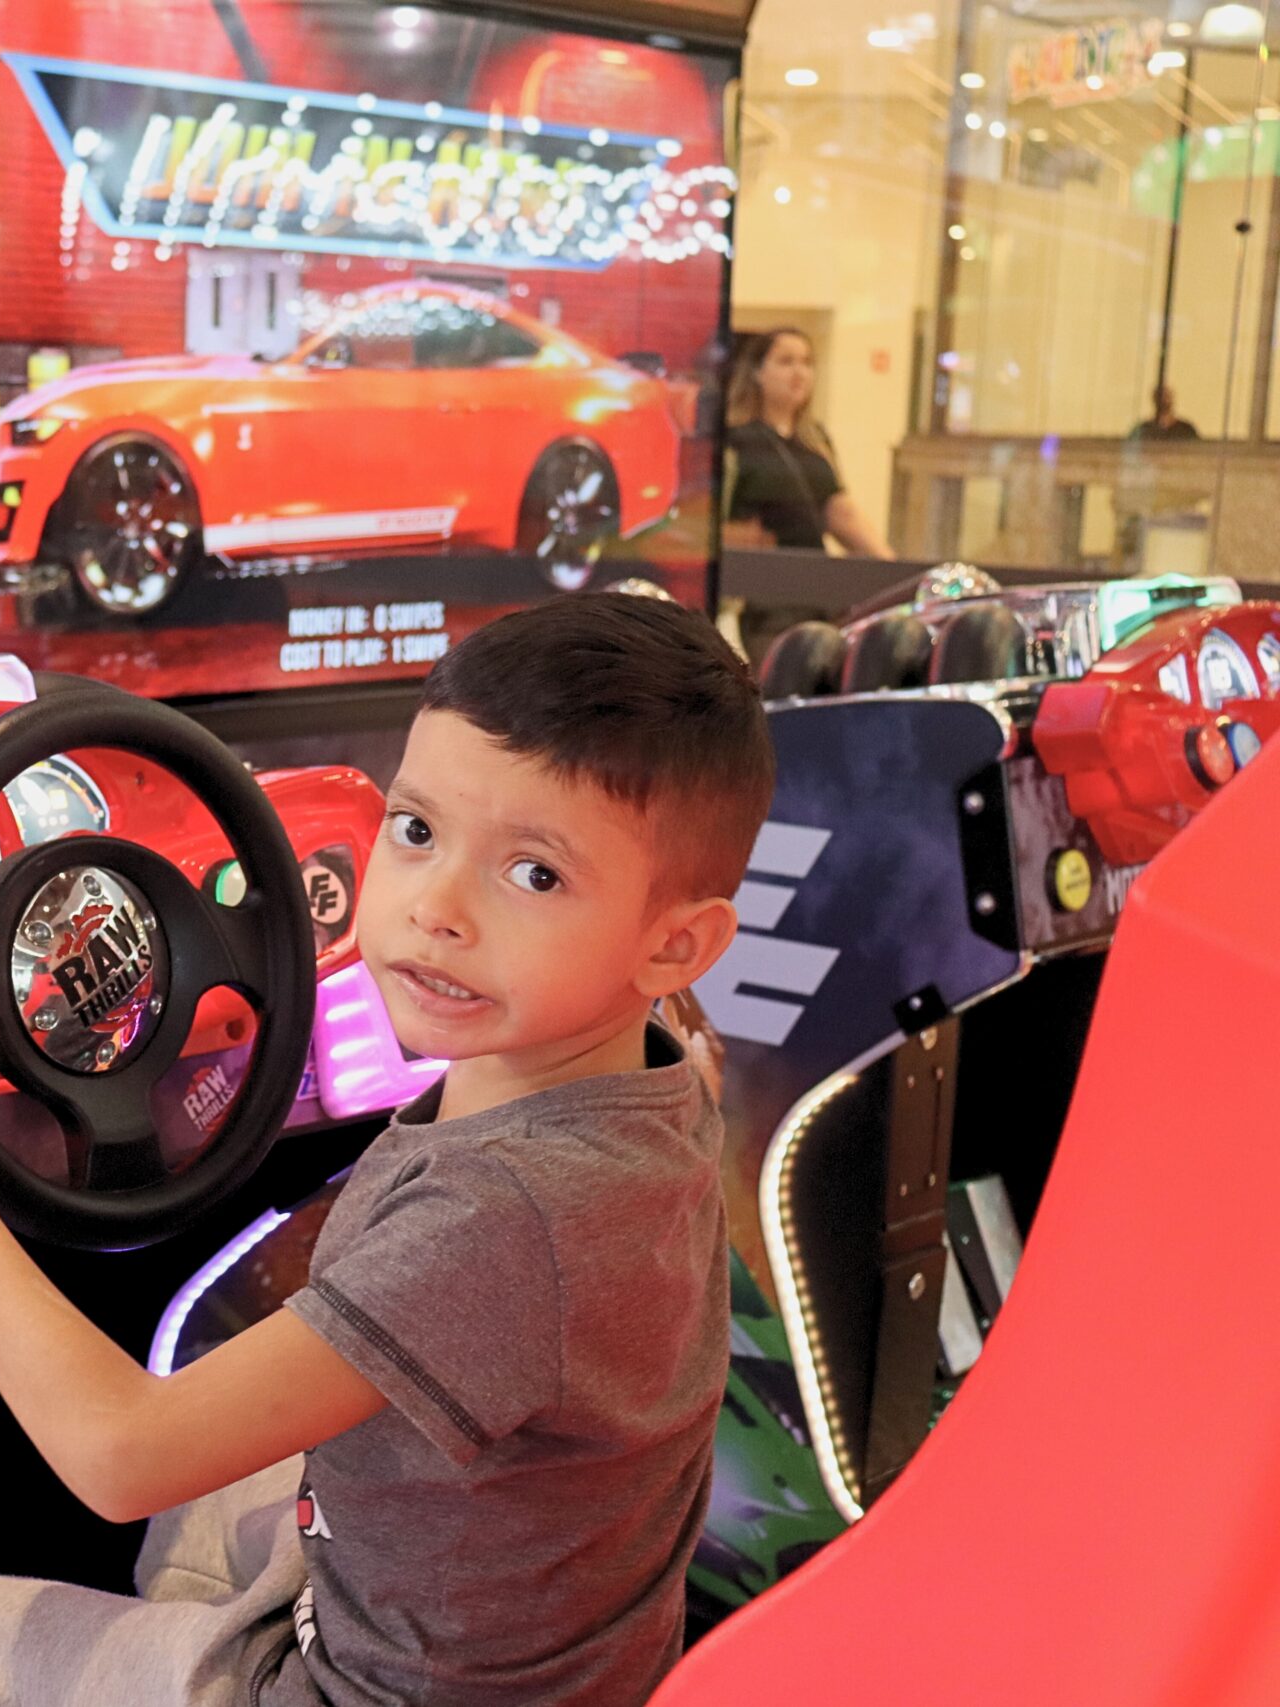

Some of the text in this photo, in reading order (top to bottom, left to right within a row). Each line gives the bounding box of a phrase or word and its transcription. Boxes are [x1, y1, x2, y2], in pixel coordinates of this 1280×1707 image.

[51, 904, 142, 1008] RAW
[72, 944, 154, 1028] THRILLS
[182, 1063, 229, 1121] RAW
[193, 1083, 236, 1132] THRILLS
